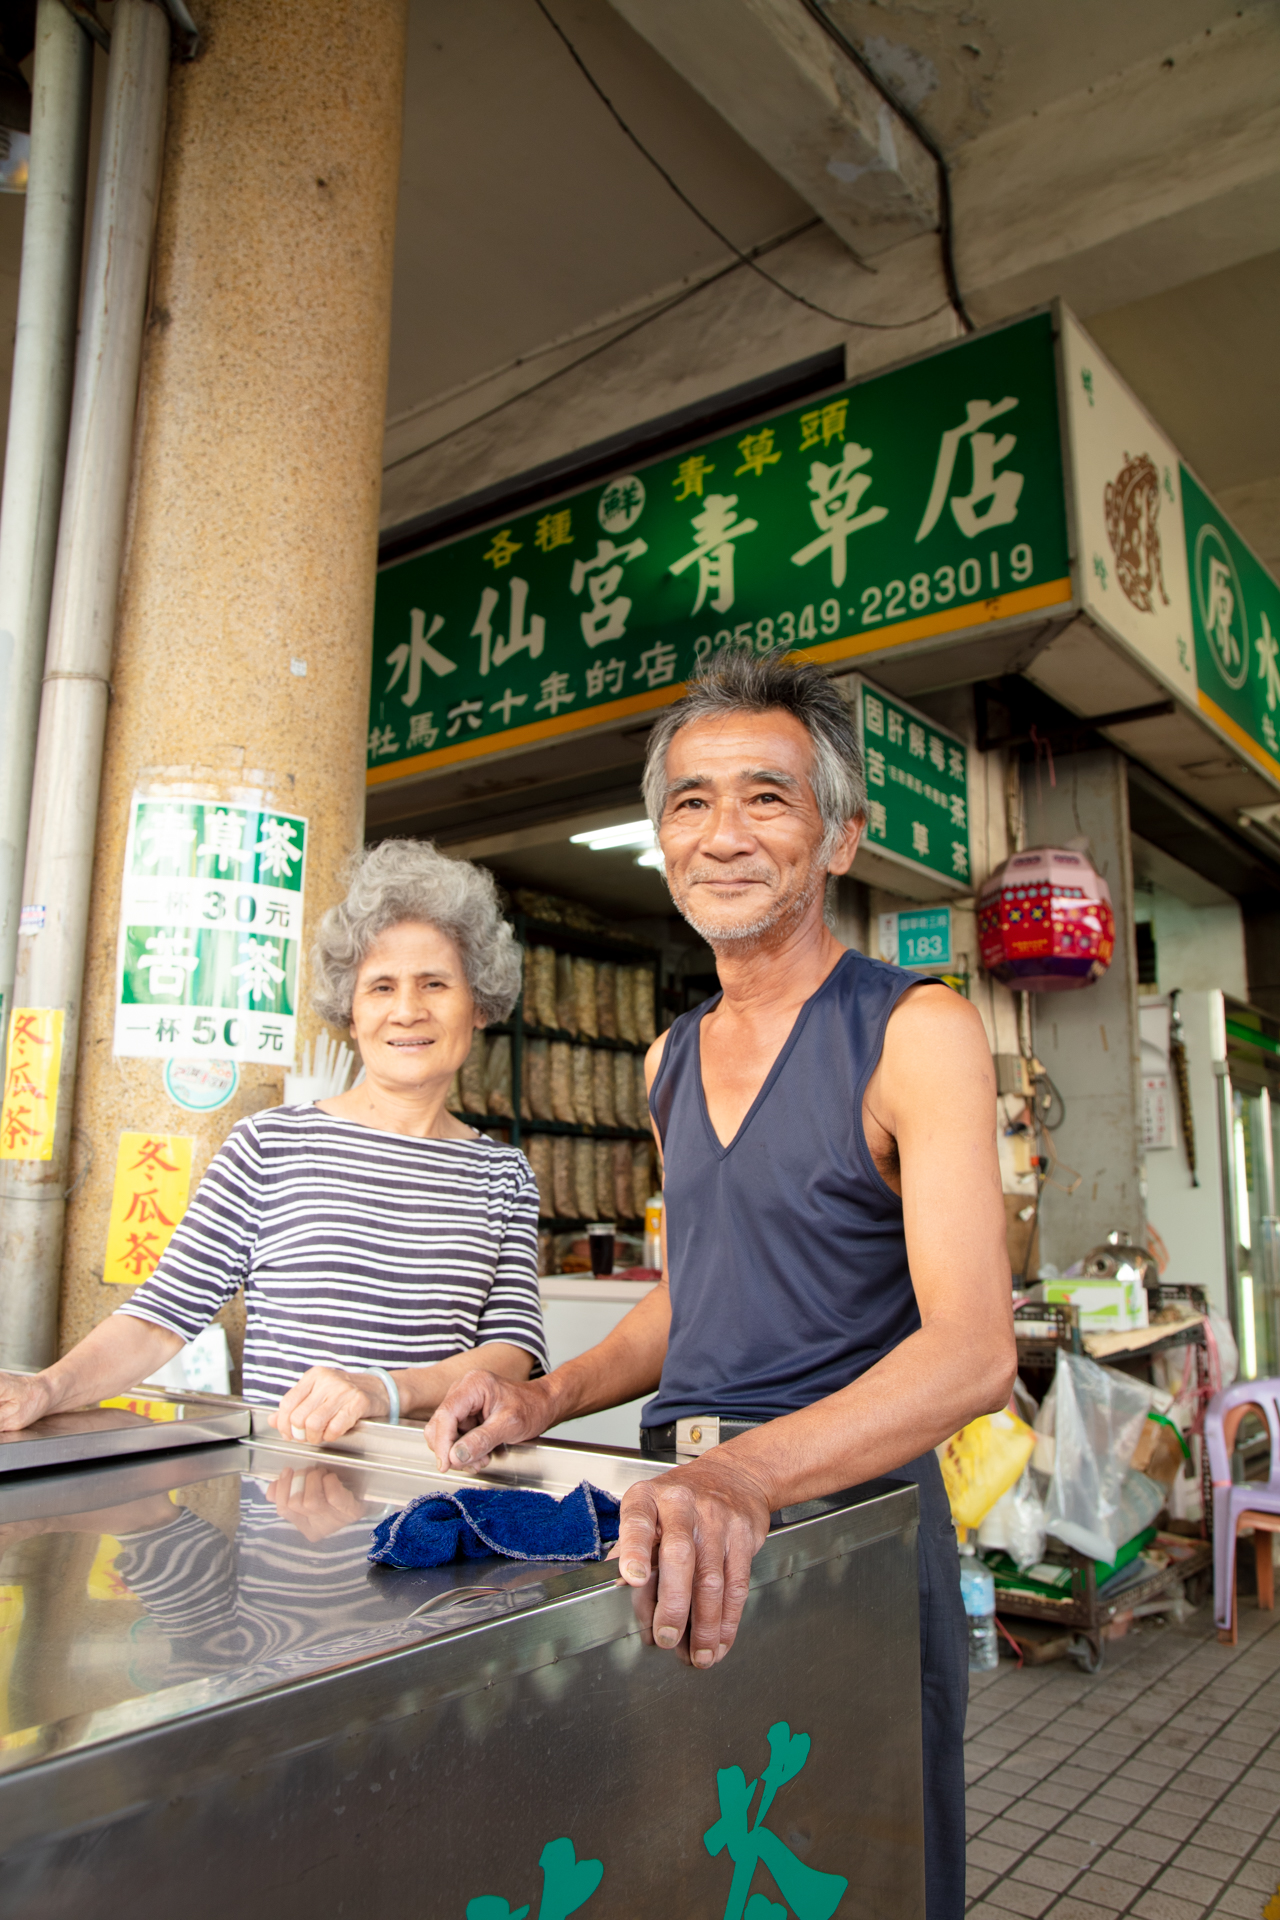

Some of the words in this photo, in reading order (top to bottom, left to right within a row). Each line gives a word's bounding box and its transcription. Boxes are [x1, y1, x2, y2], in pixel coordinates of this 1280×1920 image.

[483, 508, 575, 569] 各種
[602, 481, 640, 526] 鮮
[671, 398, 850, 501] 青草頭
[384, 396, 1024, 708] 水仙宮青草店
[1206, 554, 1241, 668] 原
[140, 805, 303, 878] 青草茶
[137, 930, 286, 1002] 苦茶
[906, 935, 943, 957] 183
[1, 1014, 53, 1151] 冬瓜茶
[126, 1015, 285, 1052] 一杯50元
[115, 1139, 181, 1276] 冬瓜茶
